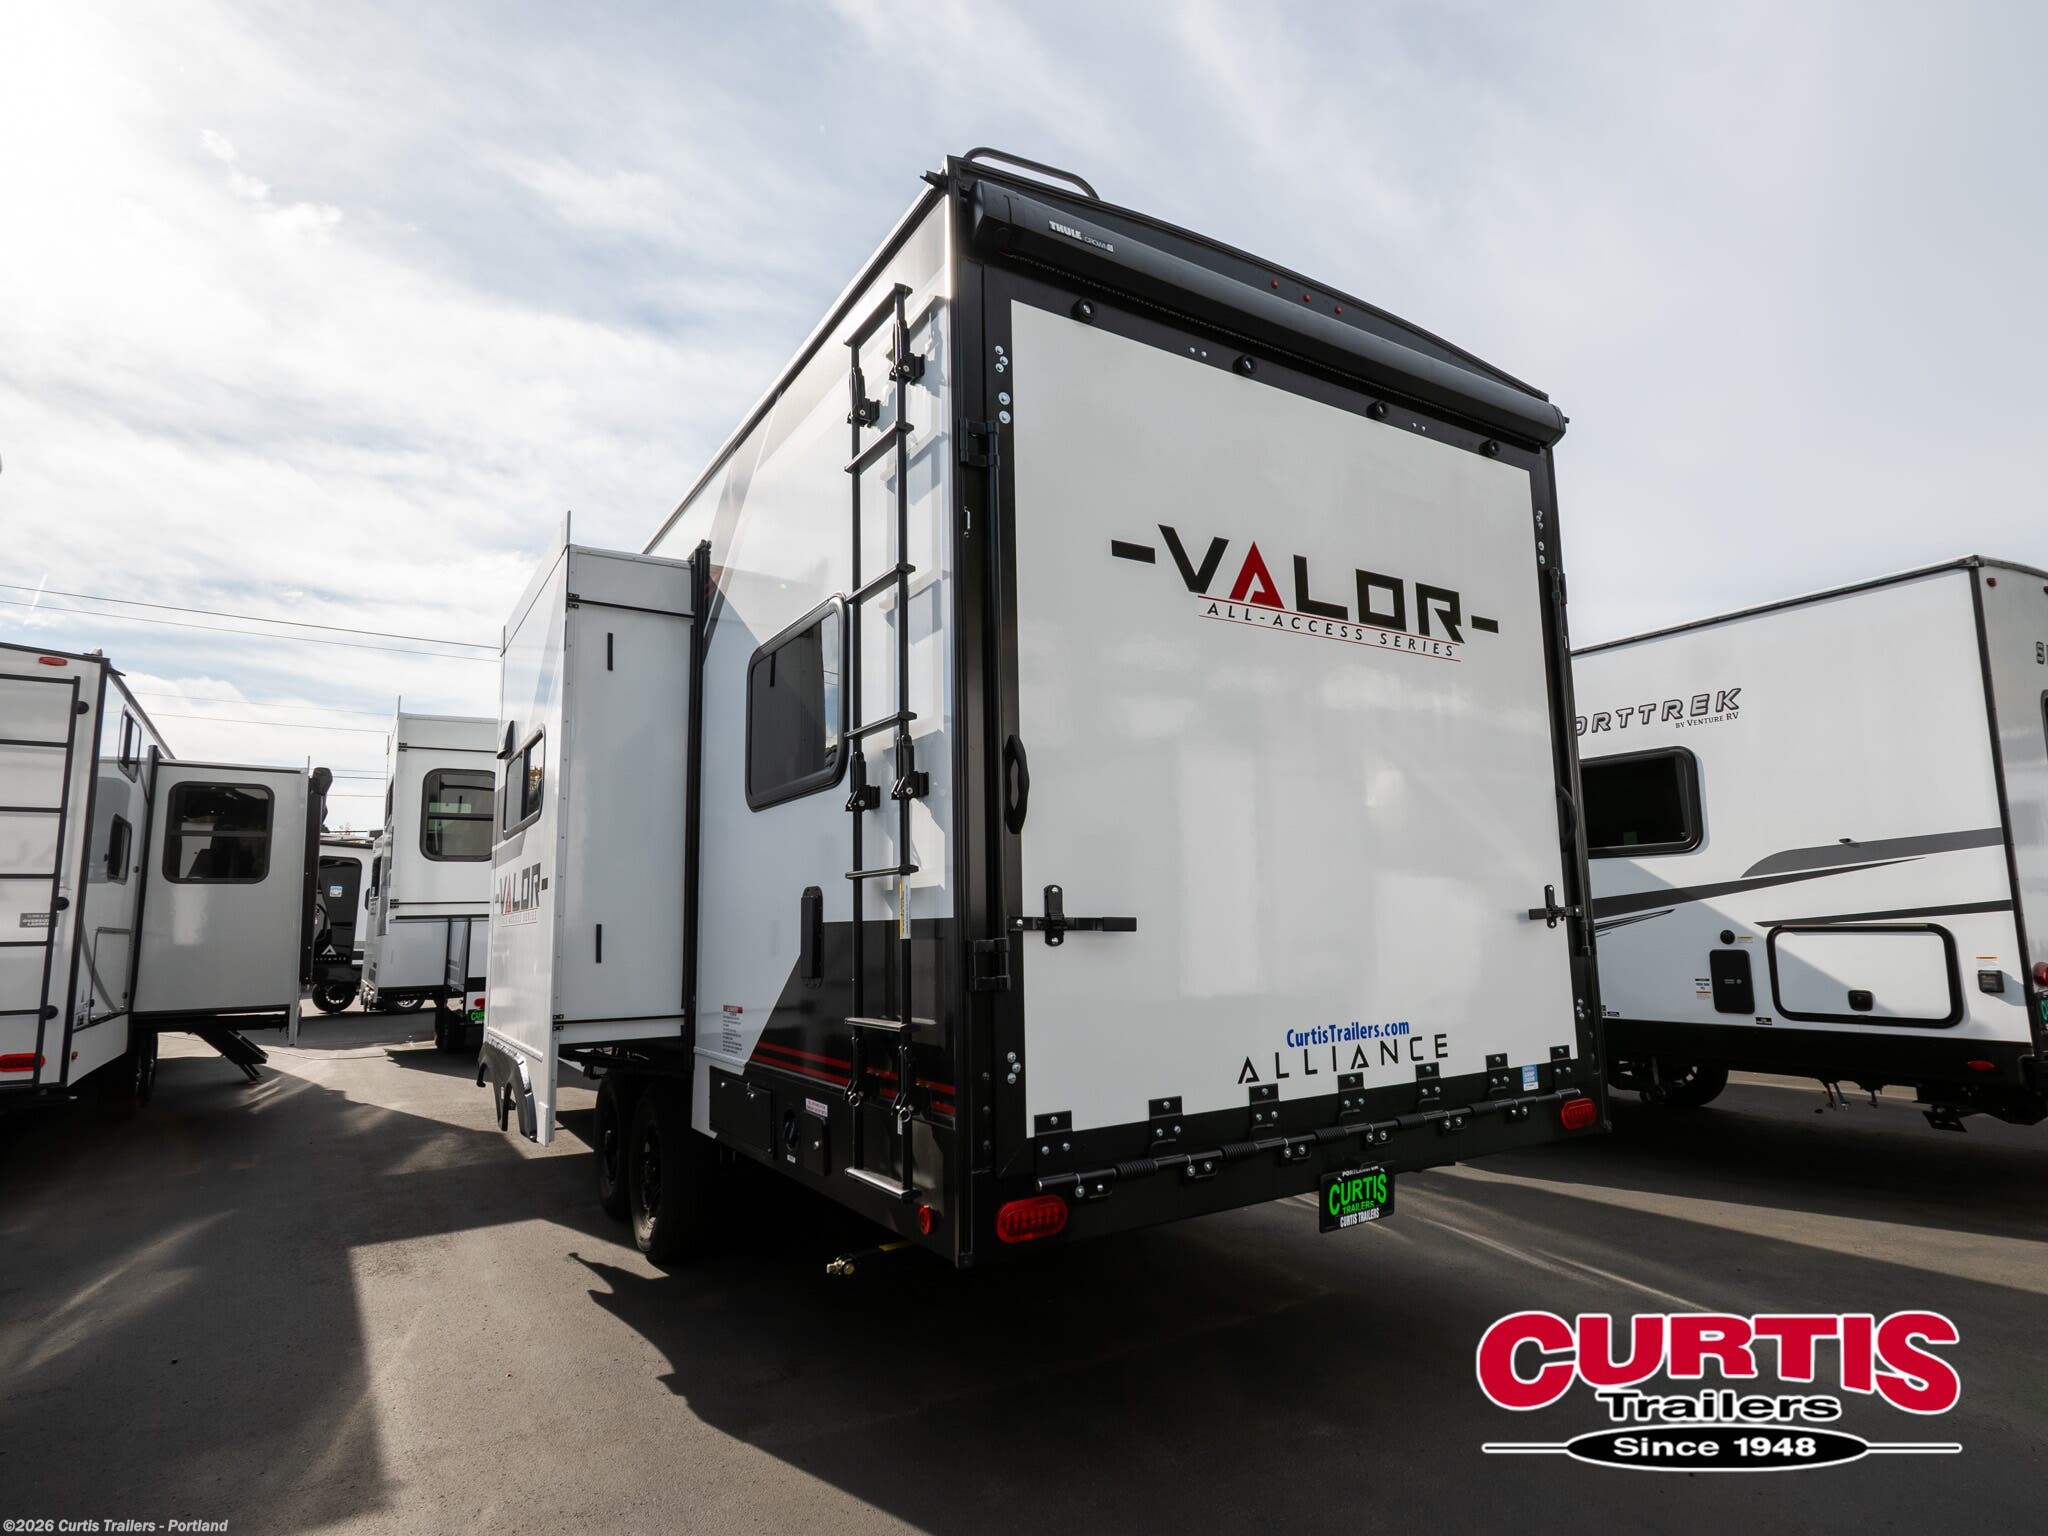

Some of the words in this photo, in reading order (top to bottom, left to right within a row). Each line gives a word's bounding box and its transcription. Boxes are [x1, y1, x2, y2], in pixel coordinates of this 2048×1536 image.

[1048, 219, 1082, 240] THULE
[1207, 602, 1364, 641] ALL-ACCESS
[1380, 631, 1454, 657] SERIES
[1686, 715, 1724, 727] VENTURE
[1725, 712, 1739, 721] RV
[1286, 1021, 1410, 1048] CurtisTrailers.com
[1237, 1033, 1449, 1085] ALLIANCE
[1329, 1173, 1387, 1215] CURTIS
[1340, 1213, 1357, 1229] CURTIS
[1358, 1207, 1380, 1223] TRAILERS
[1342, 1200, 1375, 1215] TRAILERS
